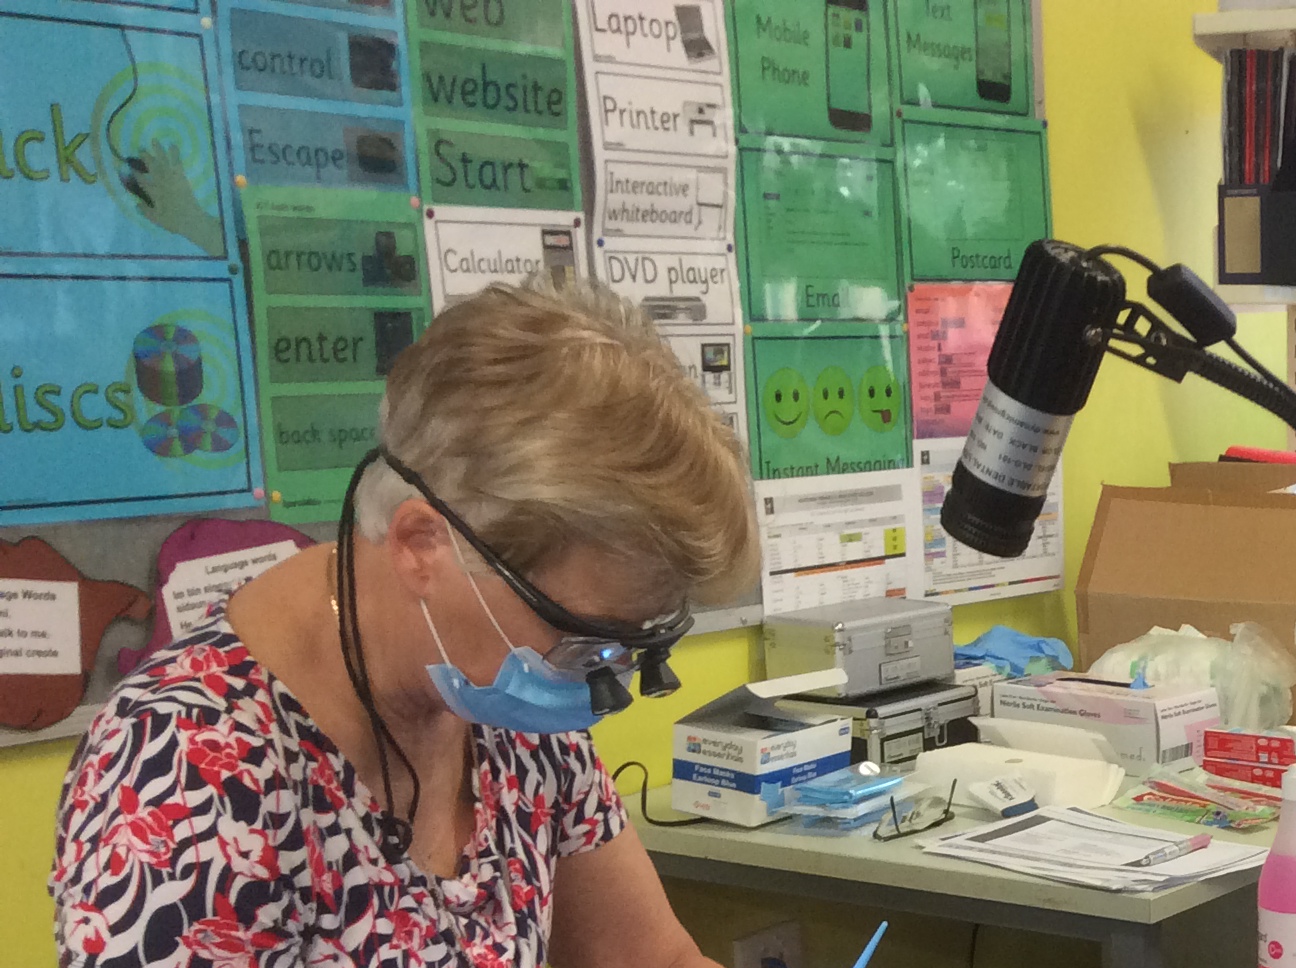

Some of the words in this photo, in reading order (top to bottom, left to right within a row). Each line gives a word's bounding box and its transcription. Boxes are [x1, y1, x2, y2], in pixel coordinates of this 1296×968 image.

[592, 0, 678, 52] Laptop
[755, 14, 810, 47] Mobile
[236, 47, 335, 80] control
[760, 55, 811, 87] Phone
[421, 63, 564, 118] website
[602, 95, 680, 132] Printer
[246, 125, 346, 184] Escape
[432, 138, 534, 194] Start
[607, 171, 691, 199] Interactive
[606, 199, 694, 226] whiteboard
[265, 246, 358, 273] arrows
[443, 249, 542, 276] Calculator
[951, 250, 1014, 271] Postcard
[607, 255, 658, 285] DVD
[667, 260, 726, 296] player
[273, 329, 365, 365] enter
[277, 422, 321, 446] back
[764, 461, 820, 479] Instant
[205, 558, 249, 575] Language
[1021, 702, 1036, 711] Soft
[1036, 703, 1077, 716] Examination
[1078, 708, 1102, 719] Gloves
[694, 764, 712, 774] Face
